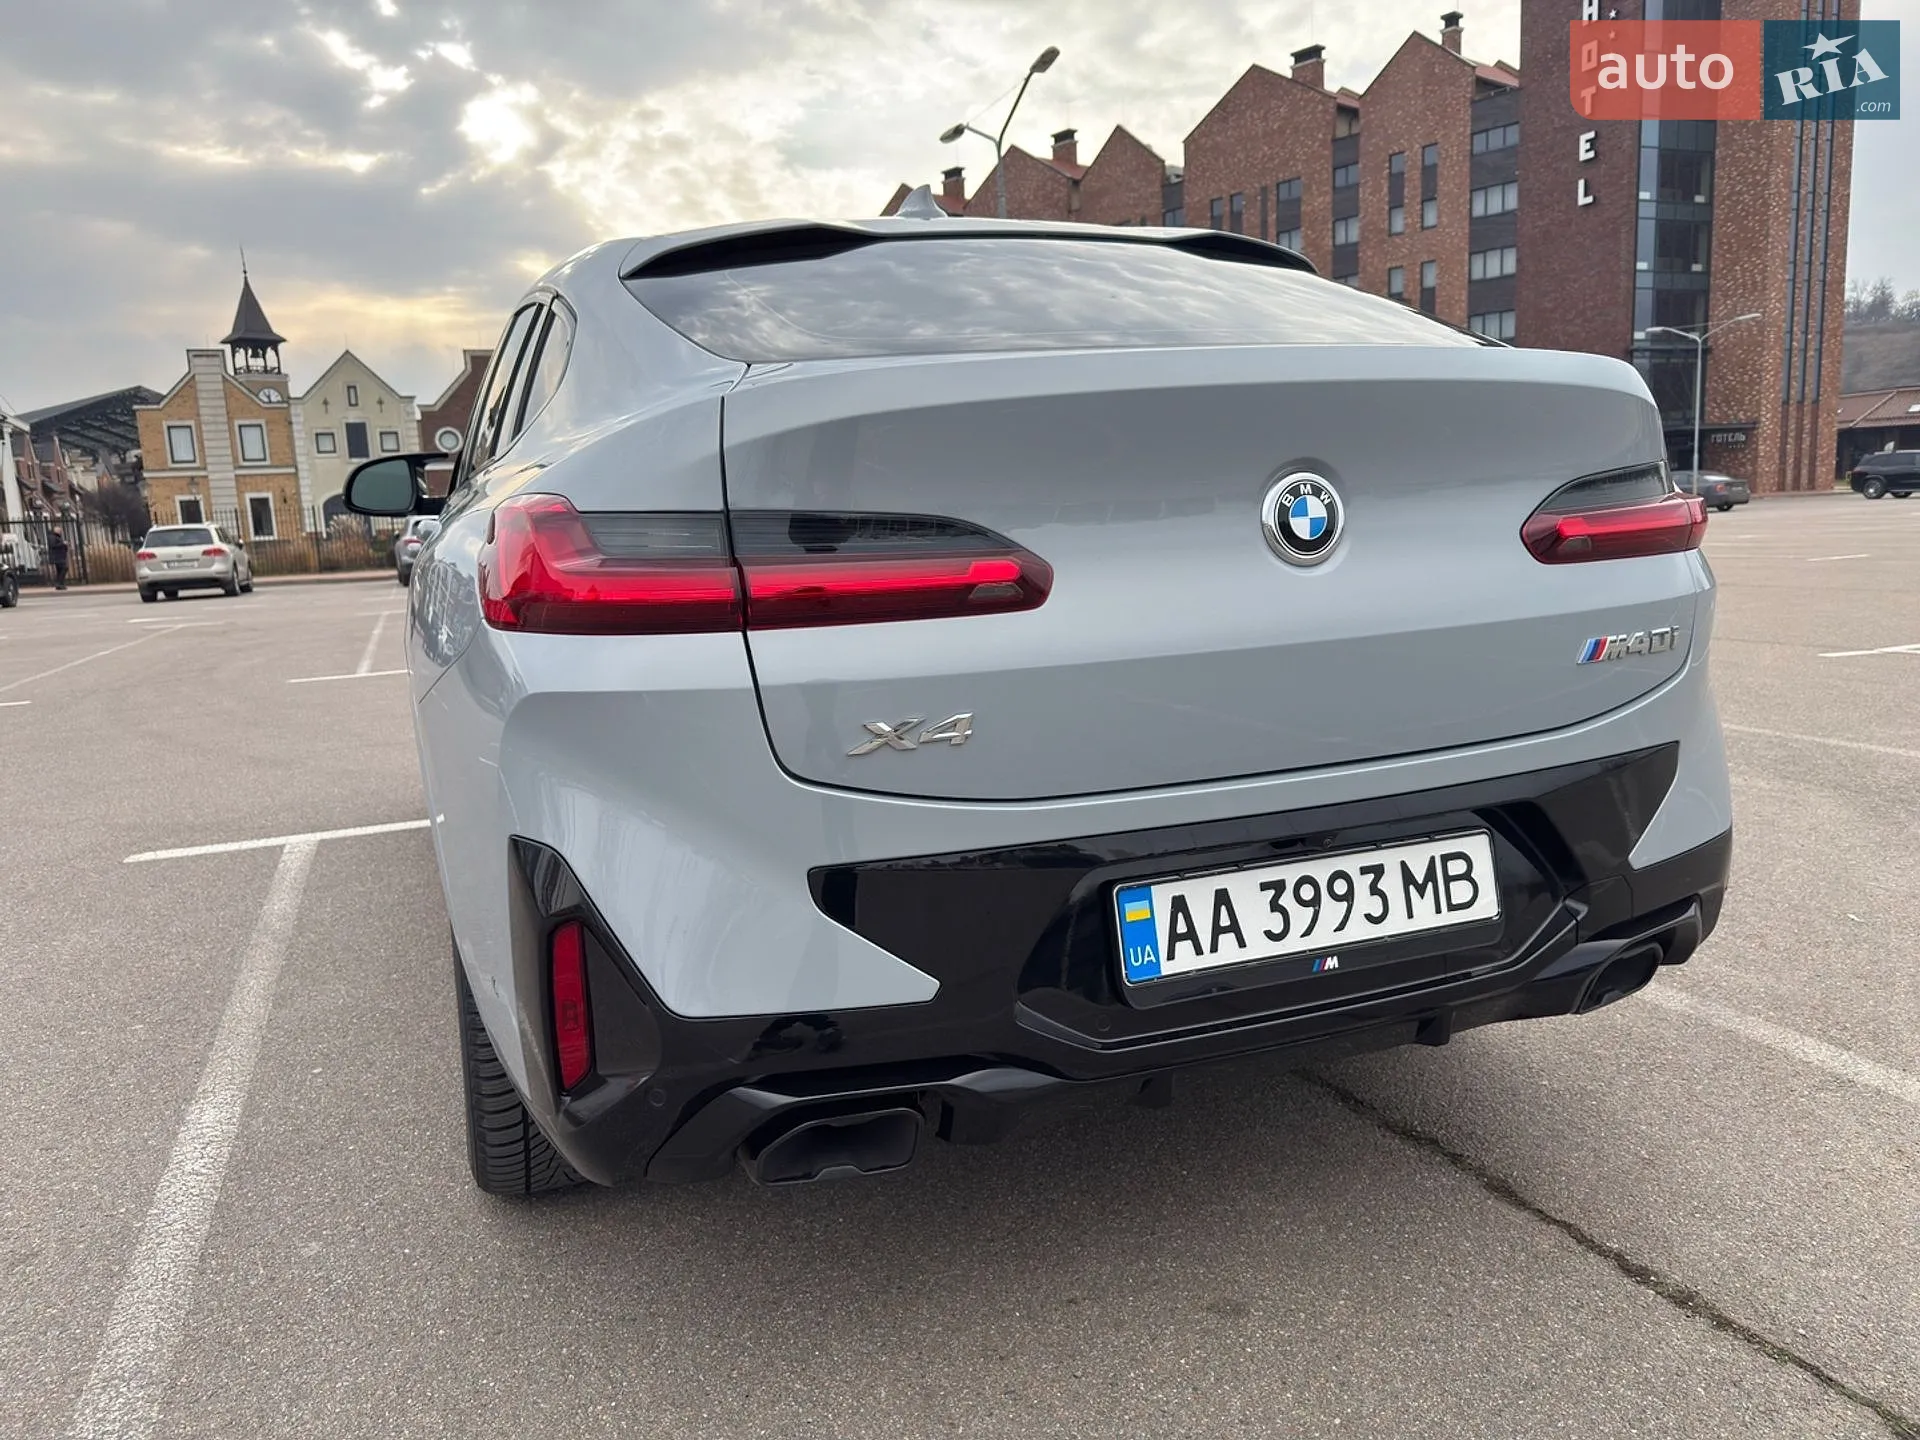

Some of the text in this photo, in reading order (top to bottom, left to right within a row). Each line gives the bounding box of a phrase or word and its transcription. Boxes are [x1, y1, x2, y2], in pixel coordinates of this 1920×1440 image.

[1577, 0, 1599, 207] HOTEL
[1281, 483, 1332, 507] BMW
[846, 711, 974, 756] X4
[1166, 850, 1480, 961] AA 3993 MB
[1129, 944, 1156, 967] UA
